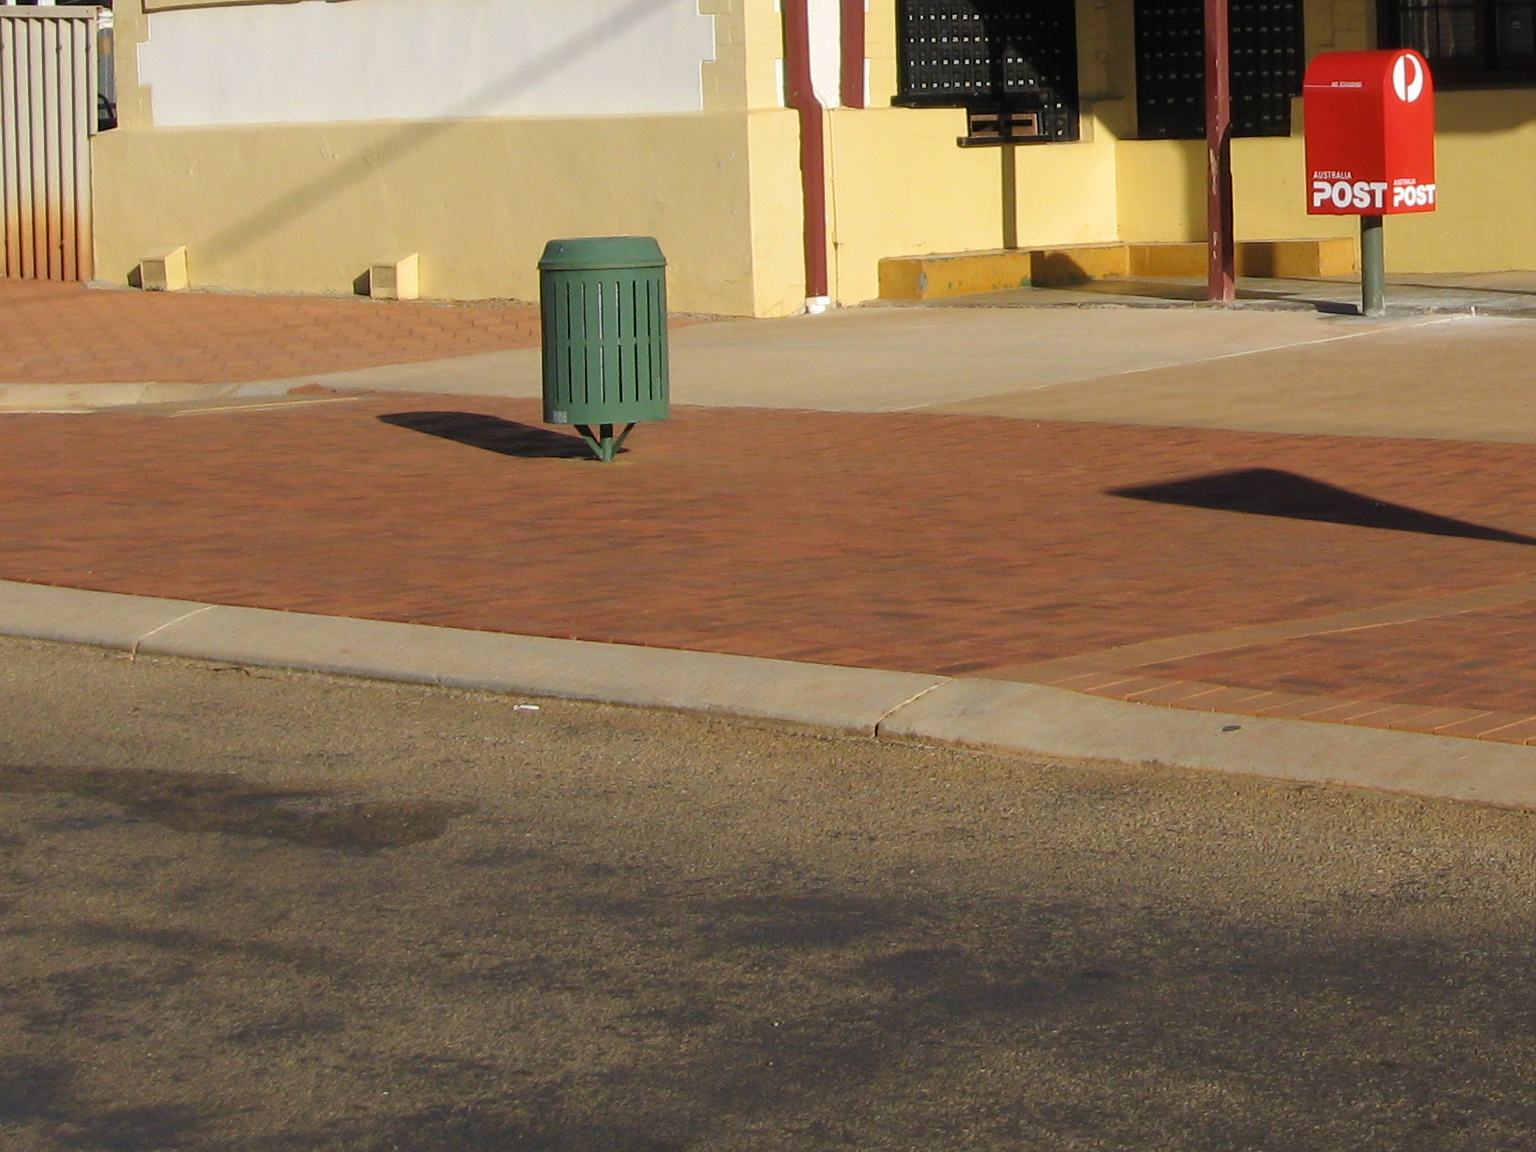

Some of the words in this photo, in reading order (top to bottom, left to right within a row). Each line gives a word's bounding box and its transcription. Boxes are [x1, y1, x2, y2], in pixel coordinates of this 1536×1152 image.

[1312, 170, 1352, 180] AUSTRALIA
[1313, 180, 1388, 209] POST
[1393, 184, 1437, 207] POST
